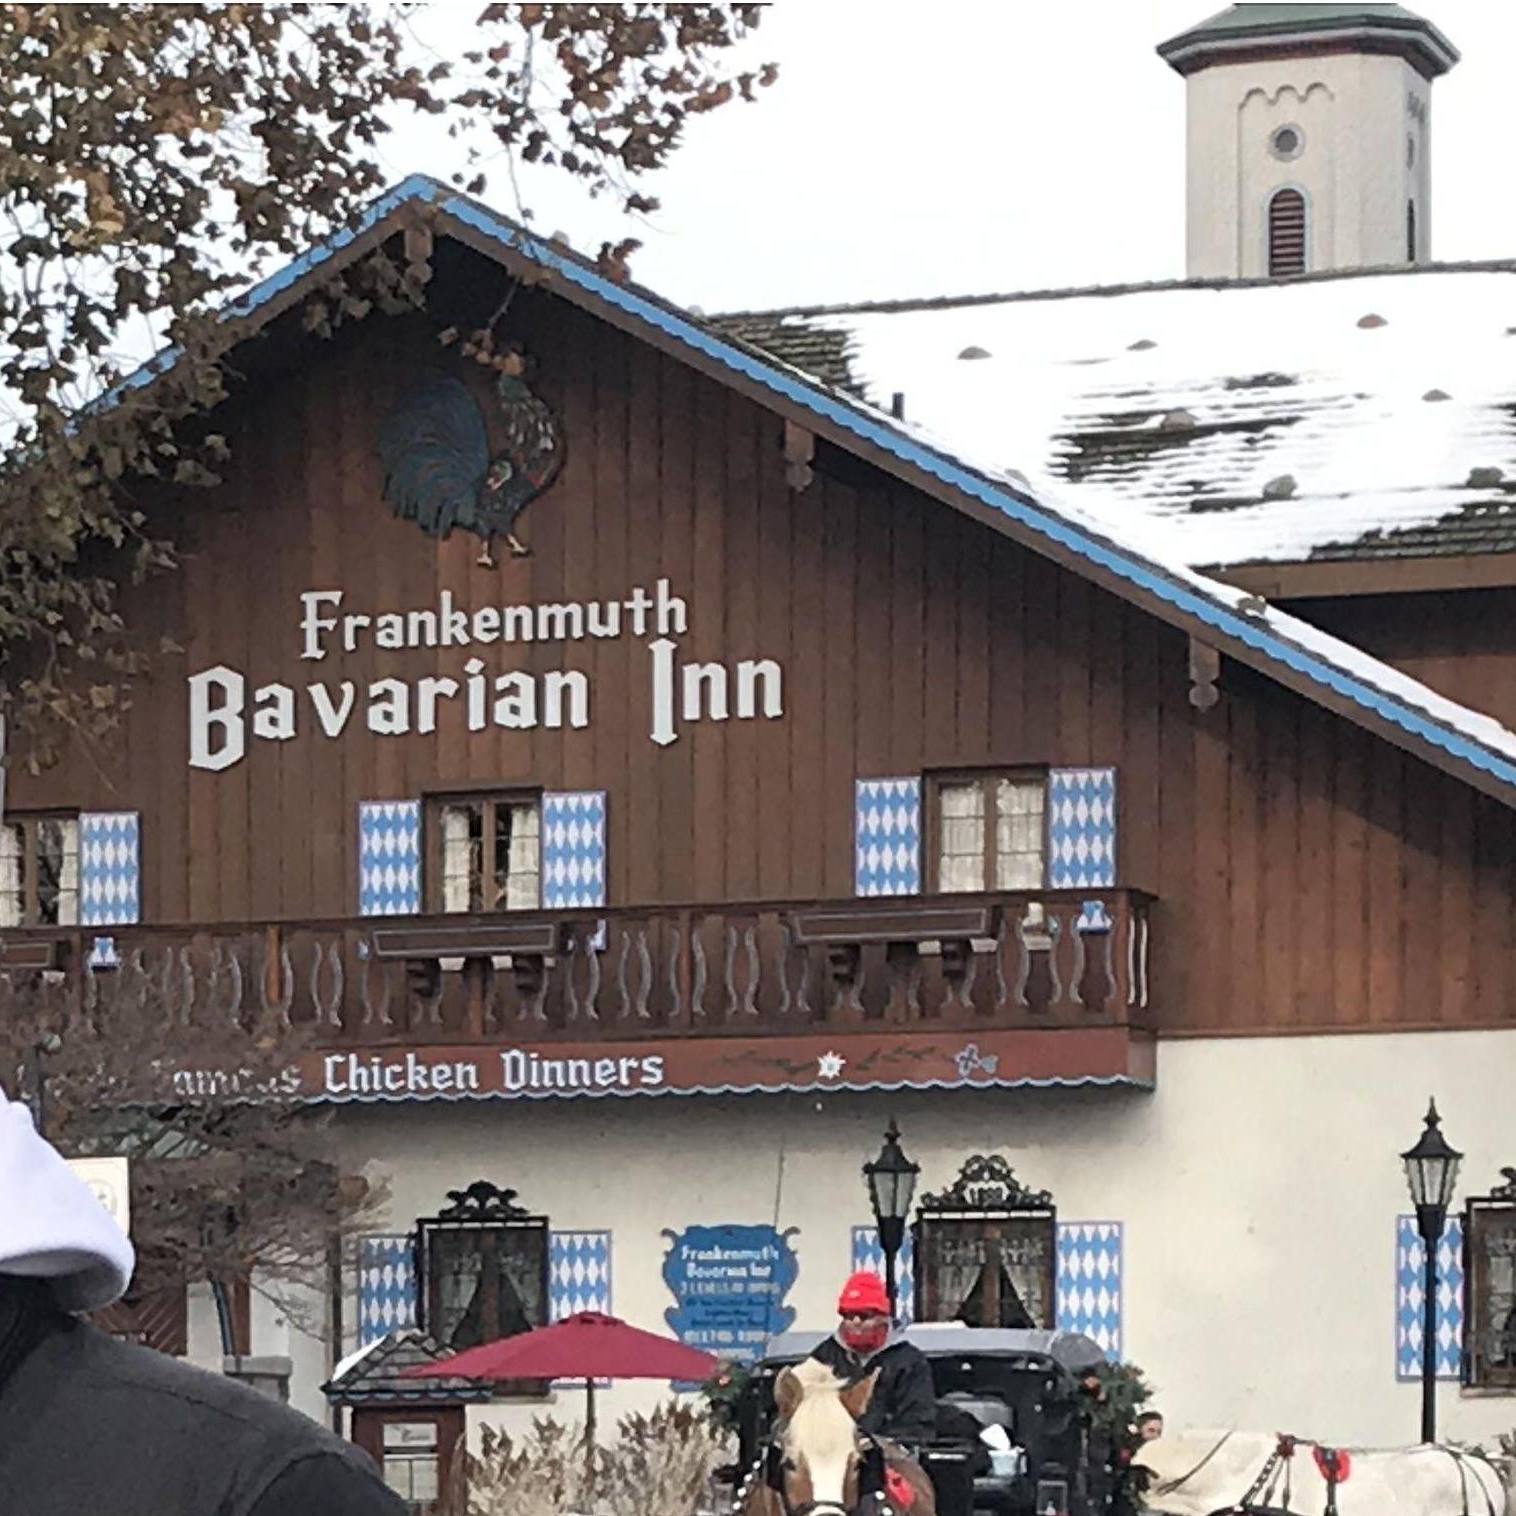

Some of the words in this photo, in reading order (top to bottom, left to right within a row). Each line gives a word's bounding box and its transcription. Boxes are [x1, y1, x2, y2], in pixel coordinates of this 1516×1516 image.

[299, 578, 687, 660] Frankenmuth
[187, 657, 588, 772] Bavarian
[647, 637, 783, 747] Inn
[149, 1057, 302, 1096] ams
[323, 1053, 479, 1093] Chicken
[501, 1048, 664, 1091] Dinners
